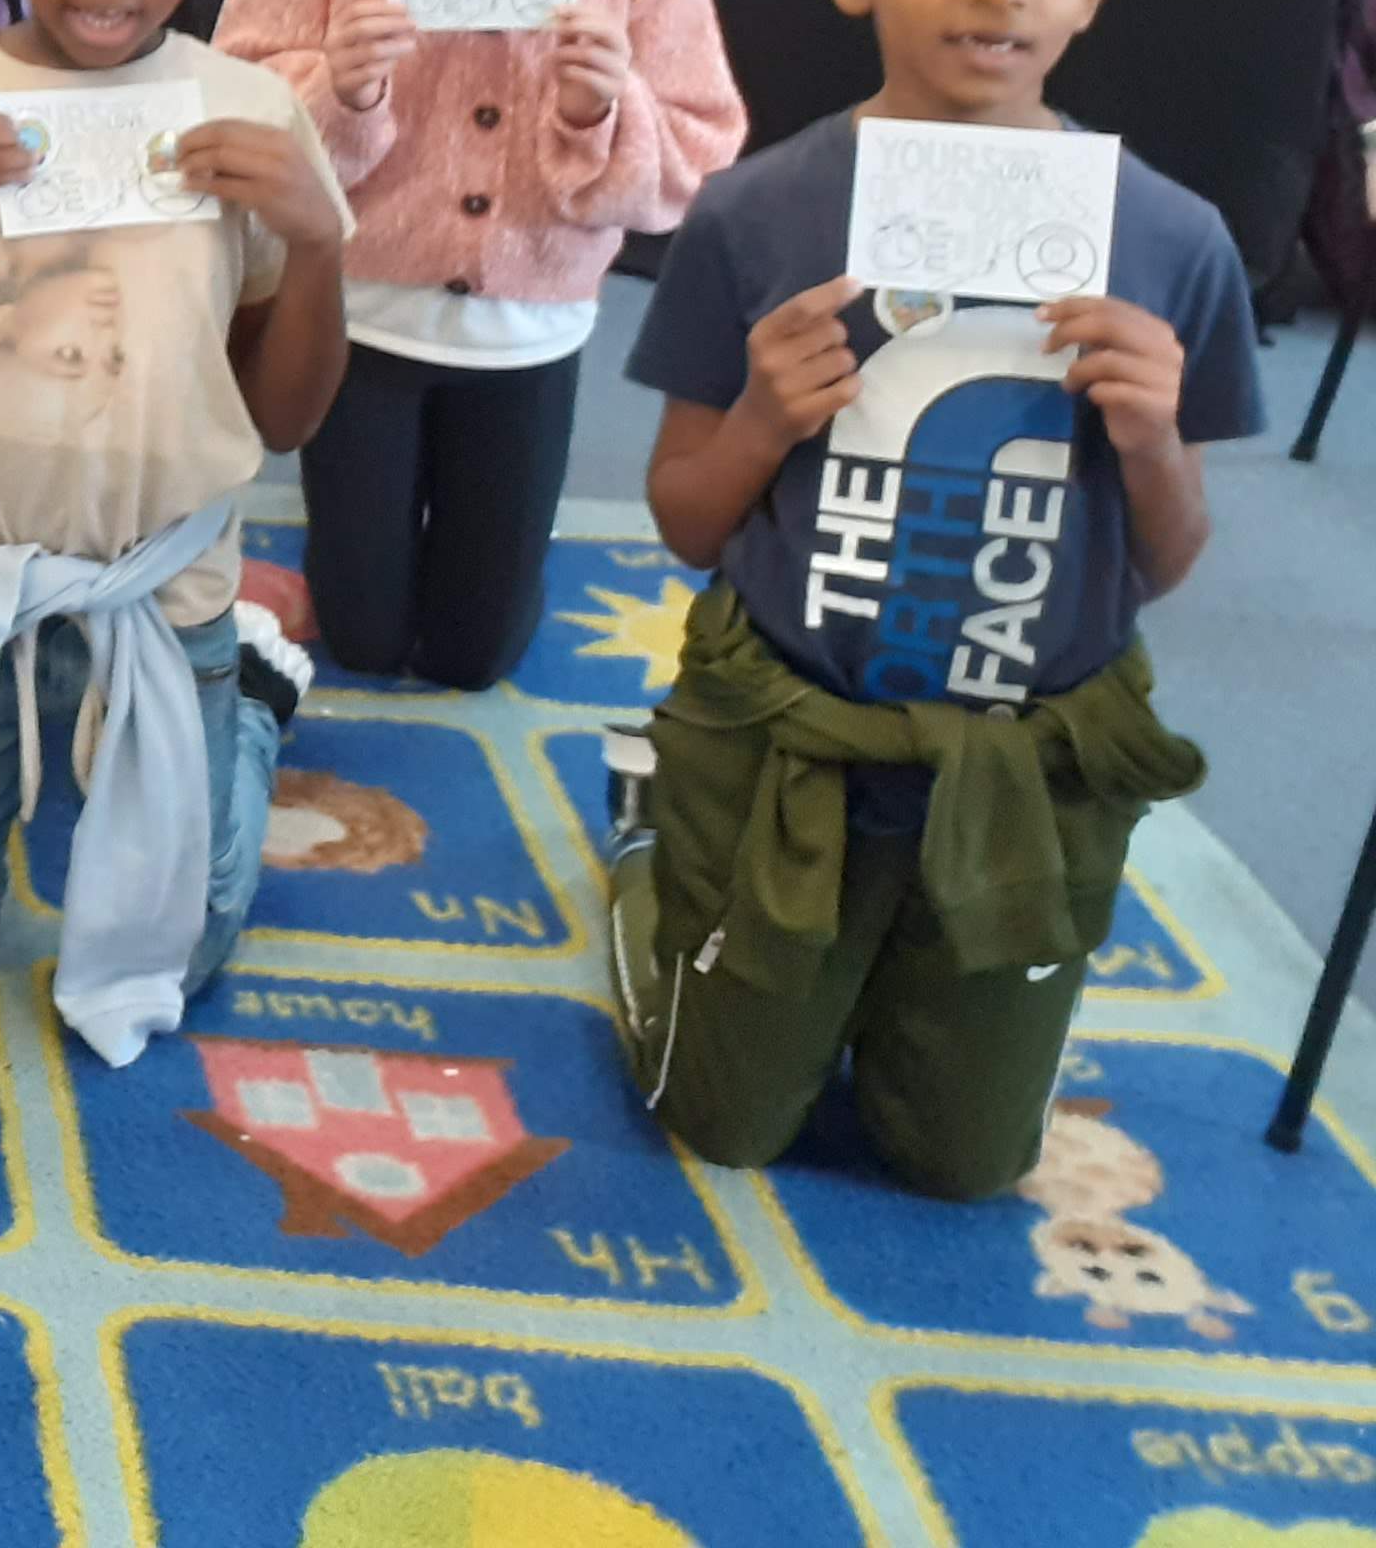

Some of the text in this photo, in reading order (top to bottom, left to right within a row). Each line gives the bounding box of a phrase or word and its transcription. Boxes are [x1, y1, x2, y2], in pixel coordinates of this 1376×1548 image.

[805, 457, 904, 629] THE
[863, 473, 985, 701] ORTH
[946, 478, 1065, 703] FACE
[234, 989, 437, 1042] house
[549, 1226, 717, 1290] Hh
[376, 1361, 543, 1428] ball
